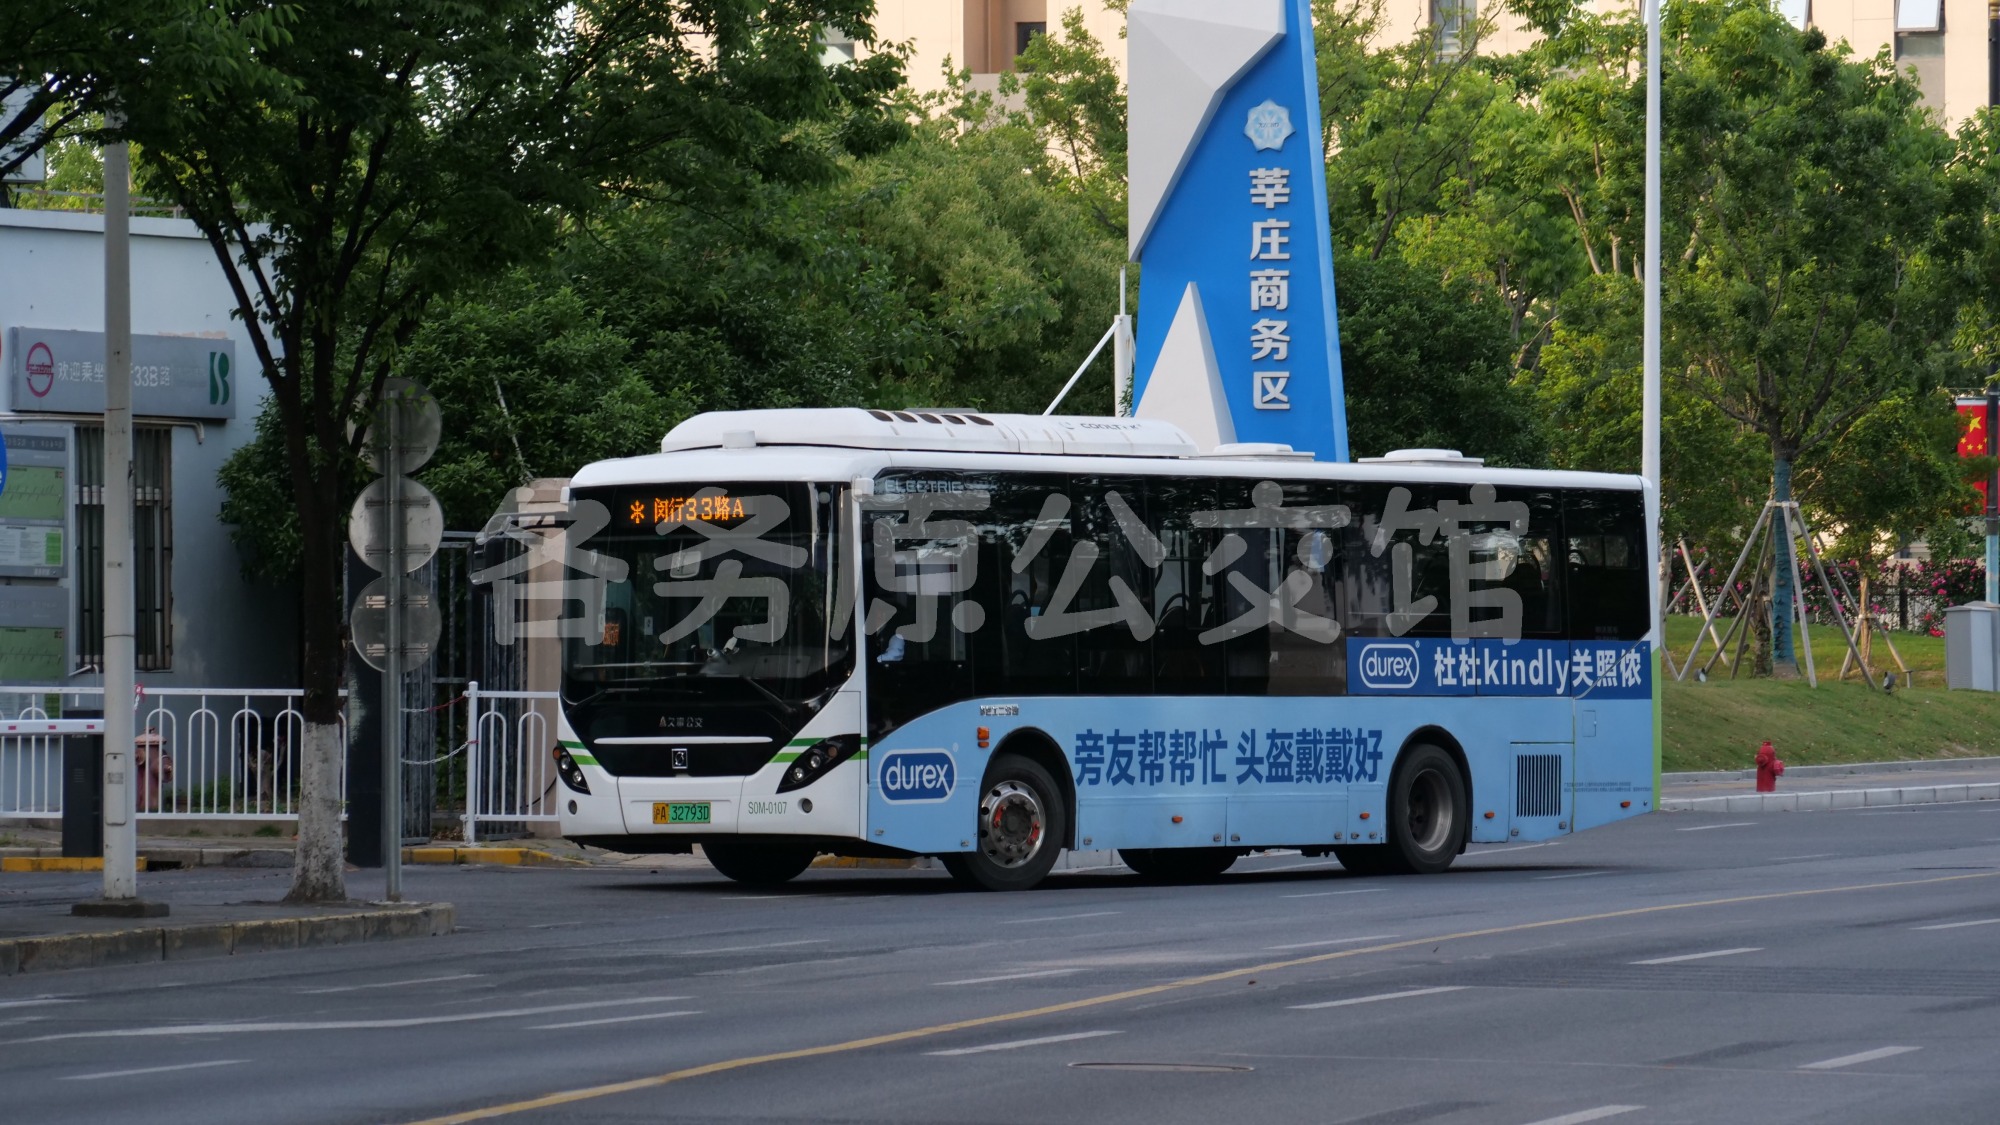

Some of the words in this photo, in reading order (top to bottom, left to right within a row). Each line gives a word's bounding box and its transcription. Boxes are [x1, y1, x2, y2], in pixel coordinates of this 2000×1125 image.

[1249, 167, 1290, 410] 莘庄商务区
[57, 360, 171, 387] 欢迎乘坐33B路
[653, 496, 744, 523] 闵行33路A
[1365, 651, 1414, 682] durex
[1434, 647, 1641, 694] 杜杜kindly关照侬
[885, 757, 949, 795] durex
[1074, 728, 1228, 787] 旁友帮帮忙
[1235, 728, 1383, 785] 头盔戴戴好
